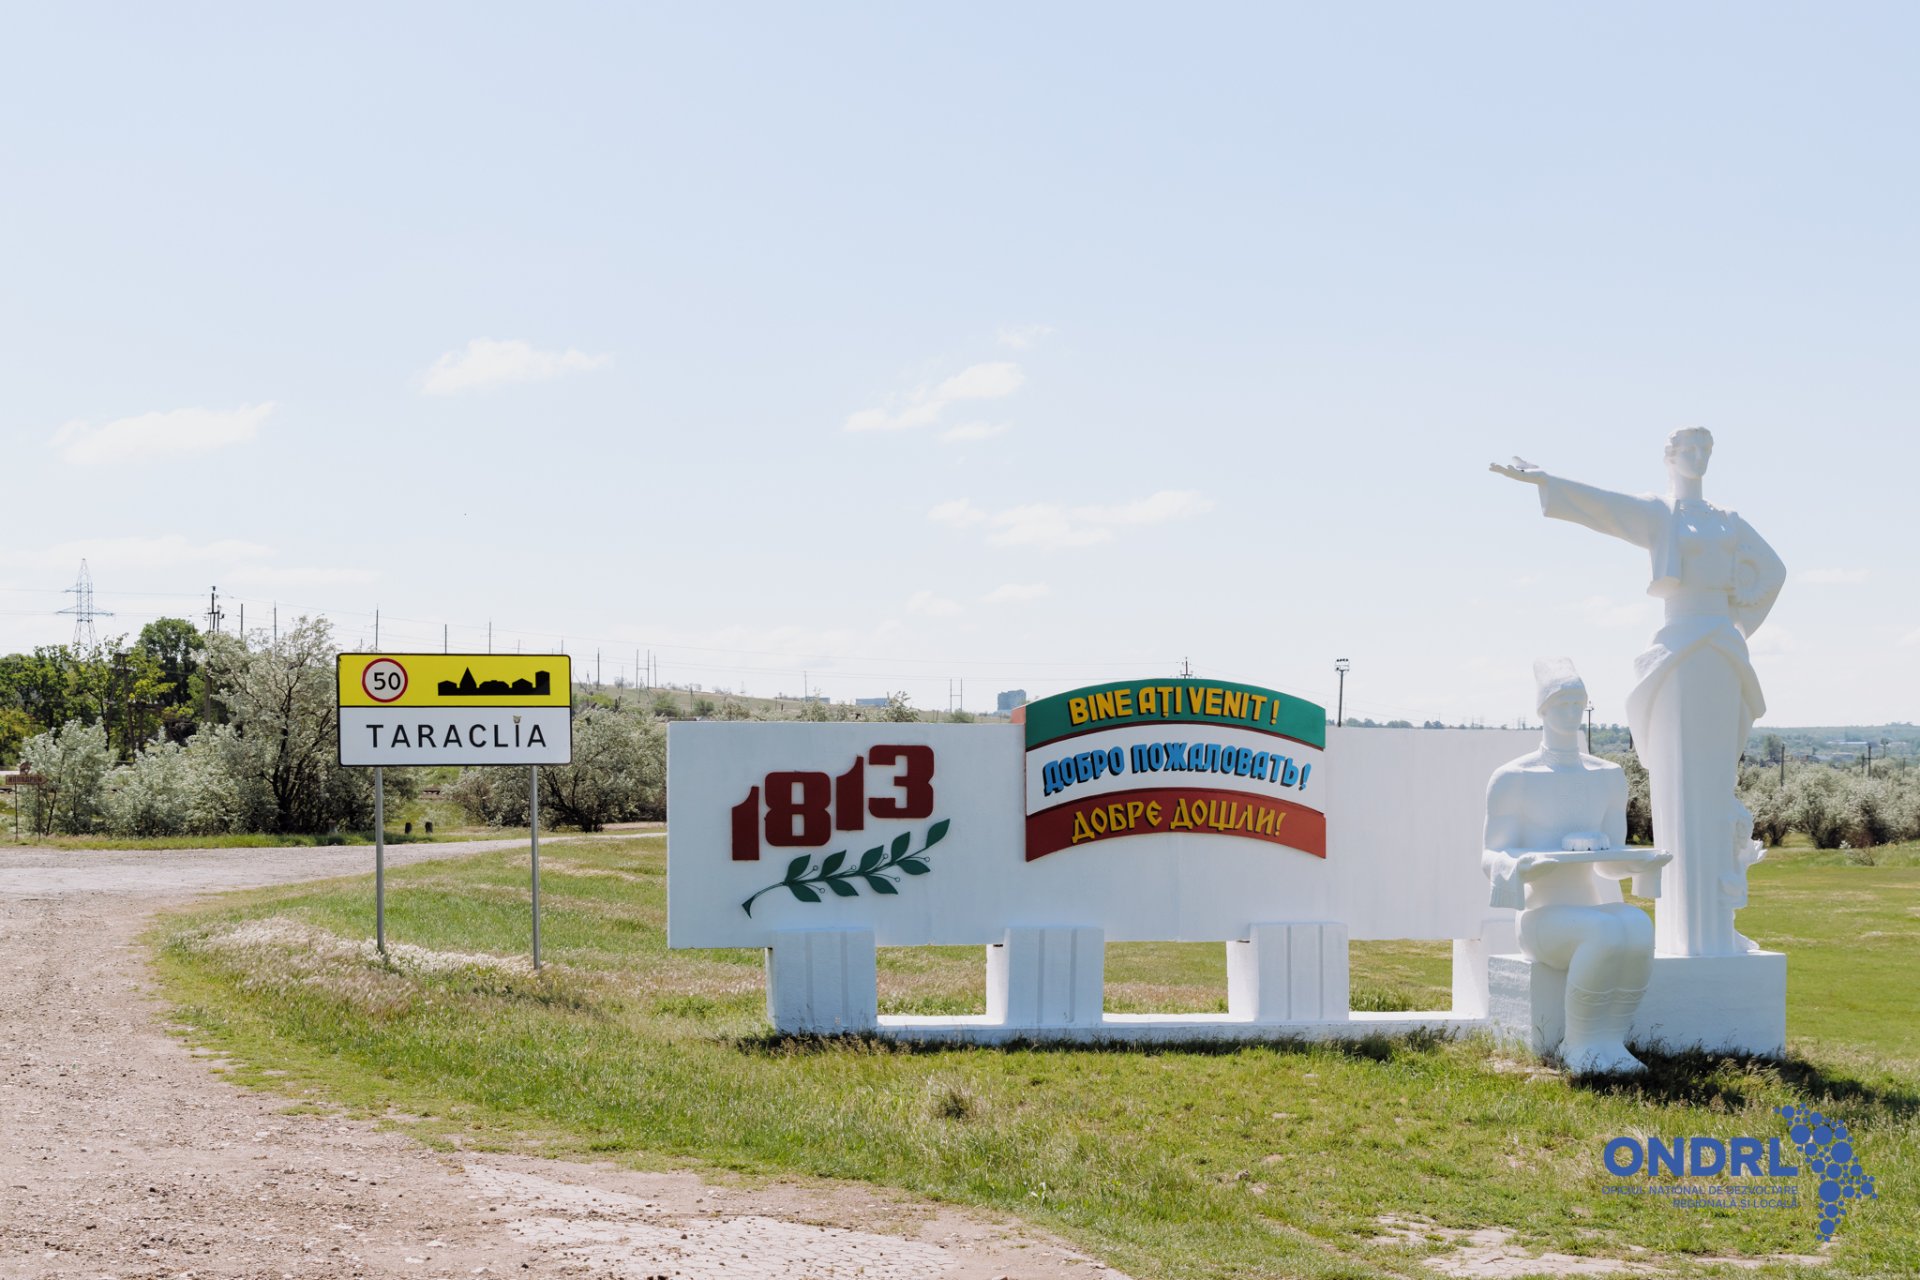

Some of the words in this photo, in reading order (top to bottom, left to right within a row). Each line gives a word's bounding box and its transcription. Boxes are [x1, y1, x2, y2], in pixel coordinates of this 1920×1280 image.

[373, 672, 401, 691] 50
[1069, 689, 1133, 726] BINE
[1043, 746, 1125, 796] ДОБРО
[1131, 743, 1312, 790] ПОЖАЛОВАТЬ!
[731, 744, 935, 861] 1813
